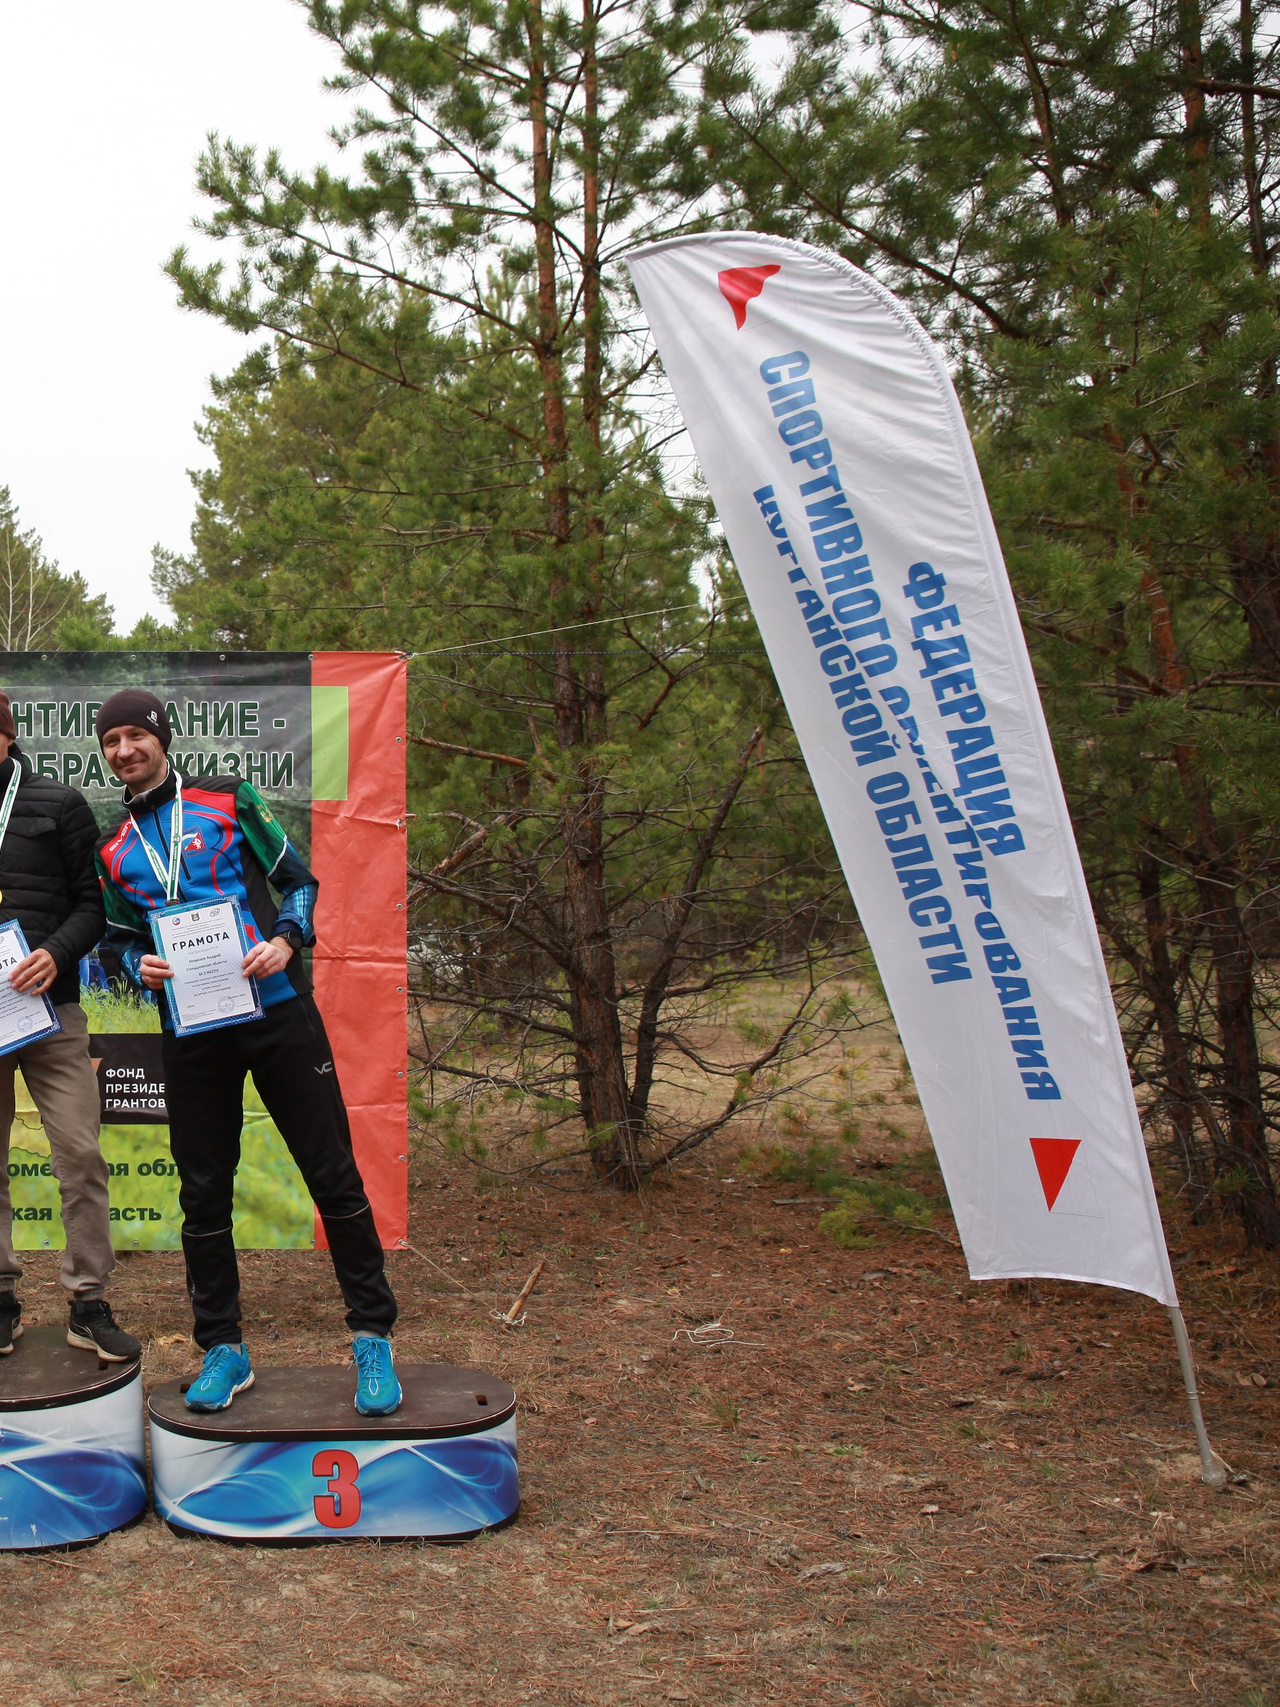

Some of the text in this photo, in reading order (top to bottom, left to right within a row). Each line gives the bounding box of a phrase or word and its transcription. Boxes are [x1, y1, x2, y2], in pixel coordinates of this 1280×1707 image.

[759, 350, 899, 679] СПОРТИВНОГО
[902, 561, 1026, 857] ФЕДЕРАЦИЯ
[865, 771, 973, 985] ОБЛАСТИ
[172, 931, 230, 952] ГРАМОТА
[105, 1068, 145, 1080] ФОНД
[105, 1083, 165, 1093] ПРЕЗИДЕ
[105, 1098, 166, 1108] ГРАНТОВ
[312, 1449, 362, 1529] 3
